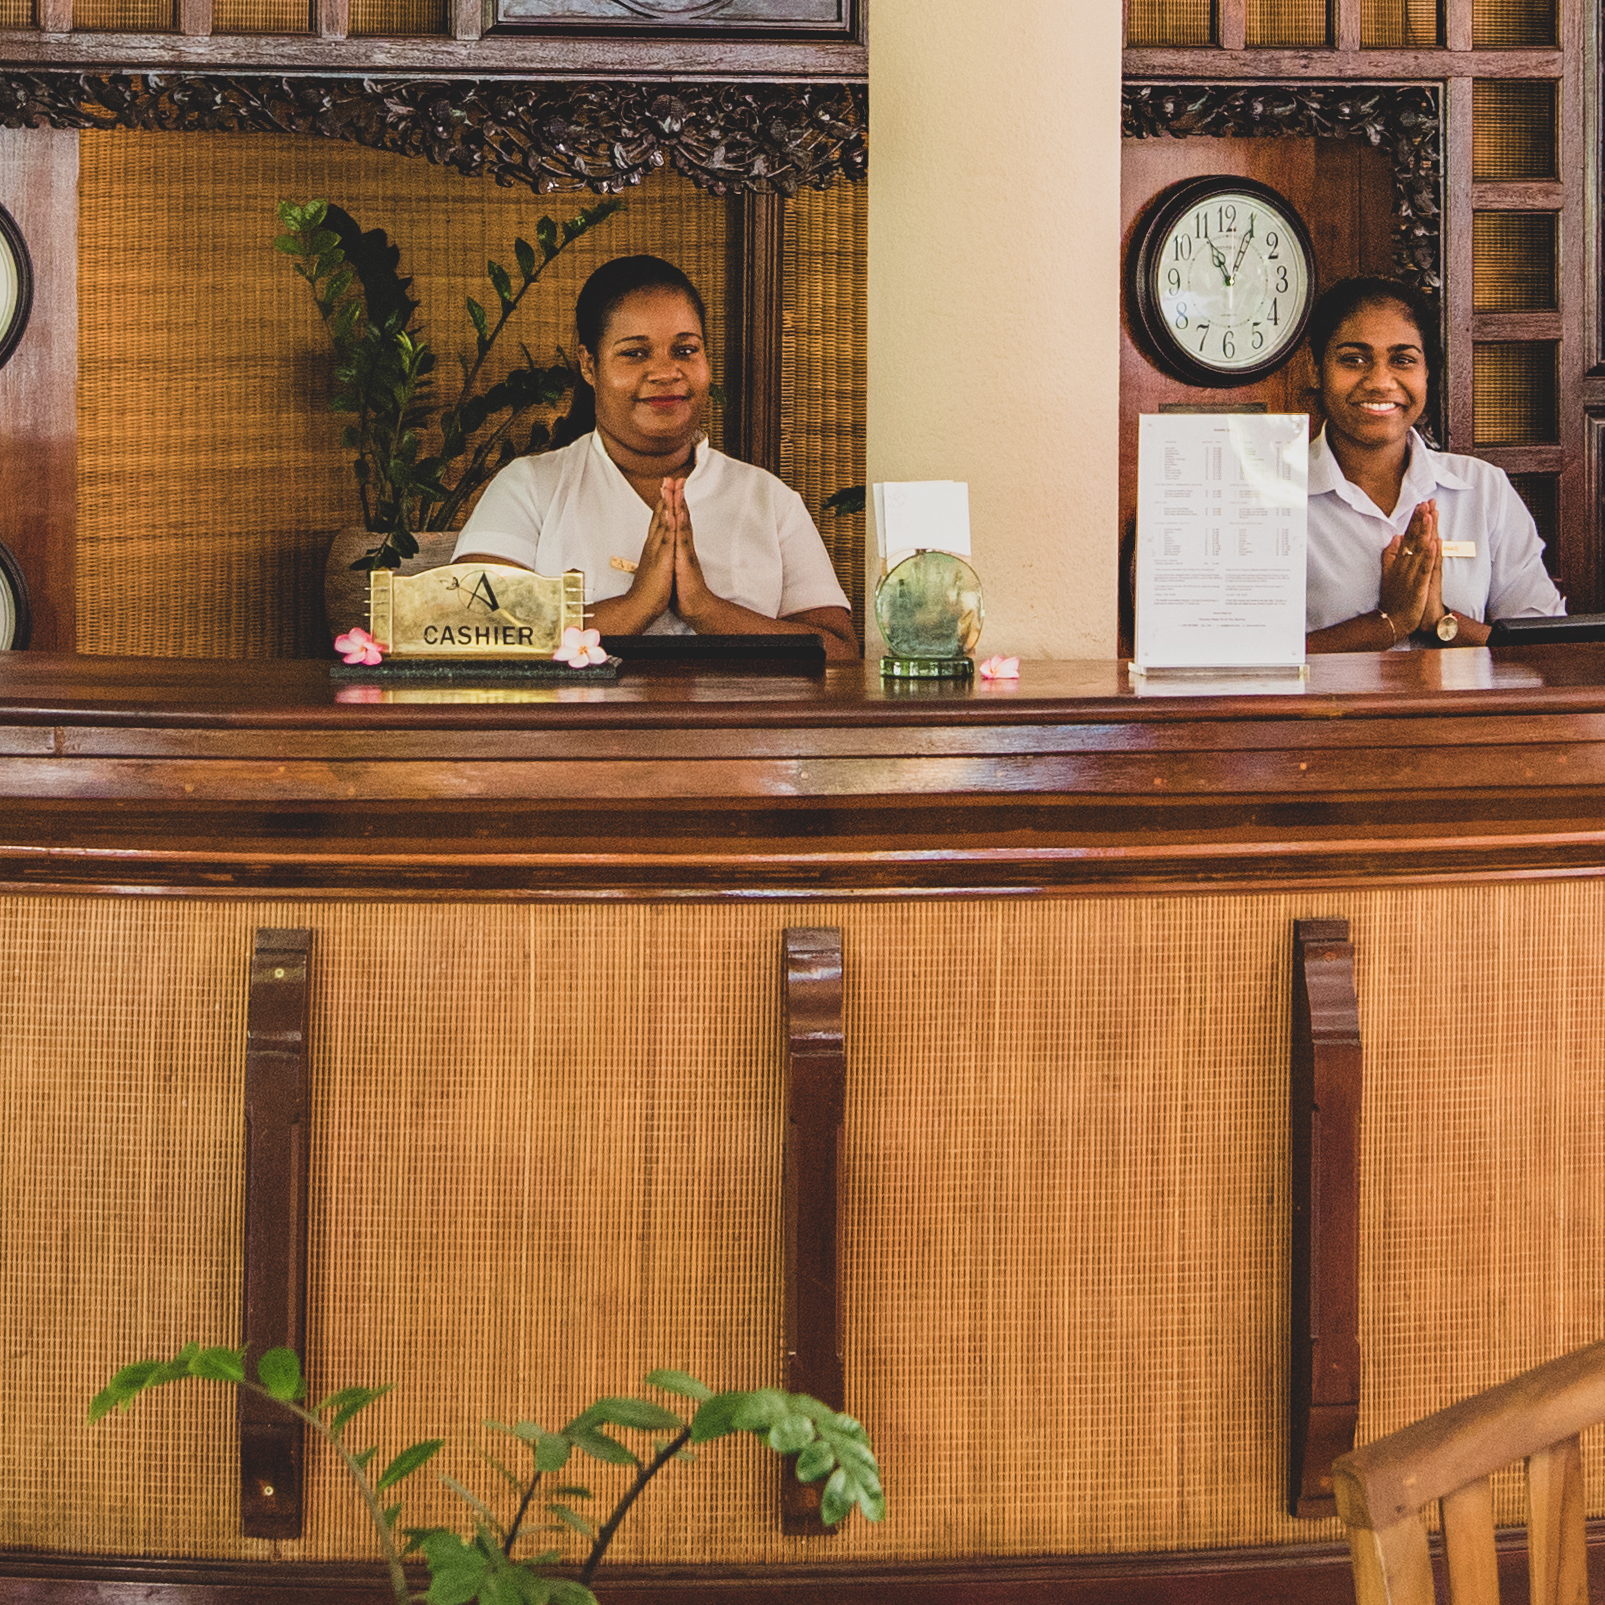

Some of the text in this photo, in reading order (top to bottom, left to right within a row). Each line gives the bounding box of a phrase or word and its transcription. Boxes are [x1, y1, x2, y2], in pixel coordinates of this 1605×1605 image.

[1195, 211, 1209, 239] 11
[1218, 205, 1237, 233] 12
[1173, 233, 1192, 261] 10
[1266, 231, 1279, 259] 2
[1167, 267, 1181, 296] 9
[1275, 265, 1289, 294] 3
[1175, 301, 1189, 330] 8
[1266, 297, 1279, 326] 4
[1196, 324, 1210, 352] 7
[1222, 330, 1236, 359] 6
[1251, 322, 1264, 350] 5
[467, 572, 500, 612] A
[424, 625, 534, 646] CASHIER
